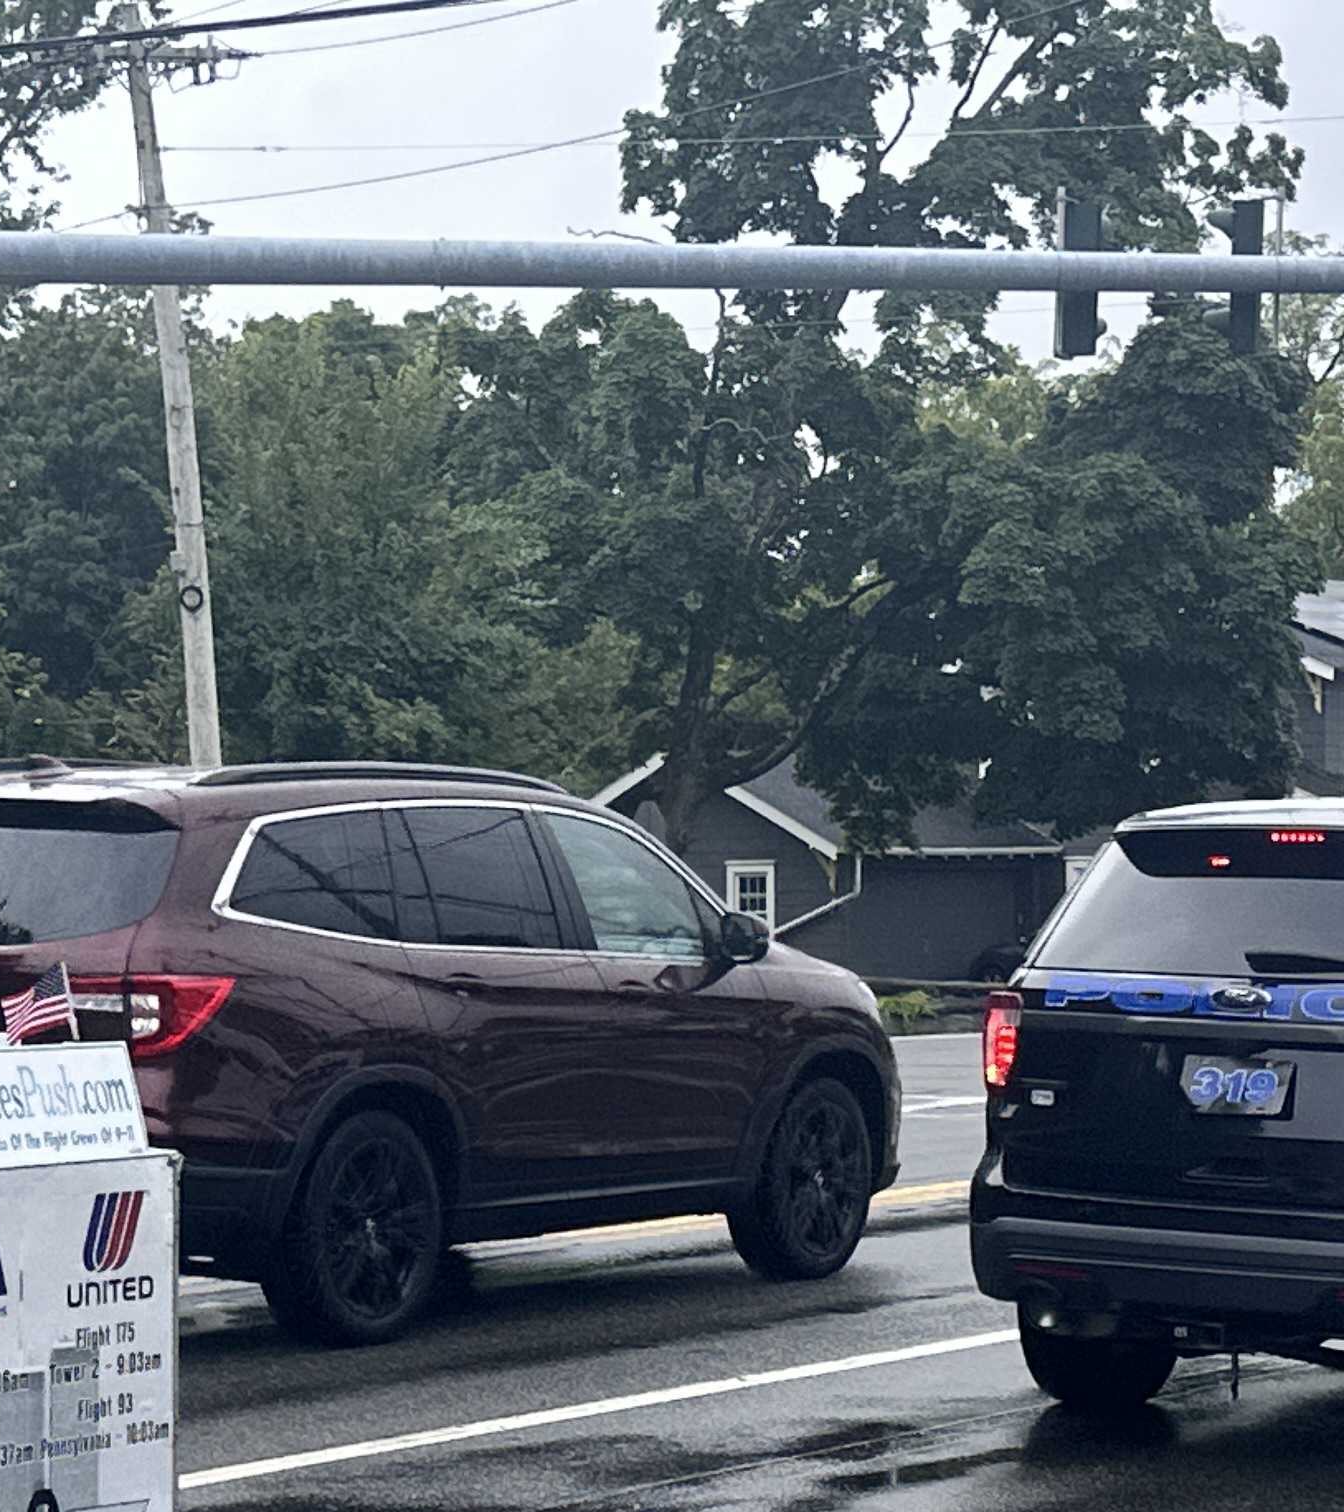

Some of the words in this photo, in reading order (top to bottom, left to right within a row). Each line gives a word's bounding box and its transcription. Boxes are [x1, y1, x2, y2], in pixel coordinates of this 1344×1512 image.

[1189, 1066, 1279, 1103] 319
[67, 1275, 154, 1308] UNITED
[75, 1325, 111, 1350] Flight
[116, 1322, 135, 1344] 175
[50, 1362, 86, 1385] Tower
[91, 1358, 100, 1379] 2
[78, 1397, 113, 1423] Flight
[117, 1393, 133, 1415] 93
[40, 1431, 111, 1459] Pennsylvania
